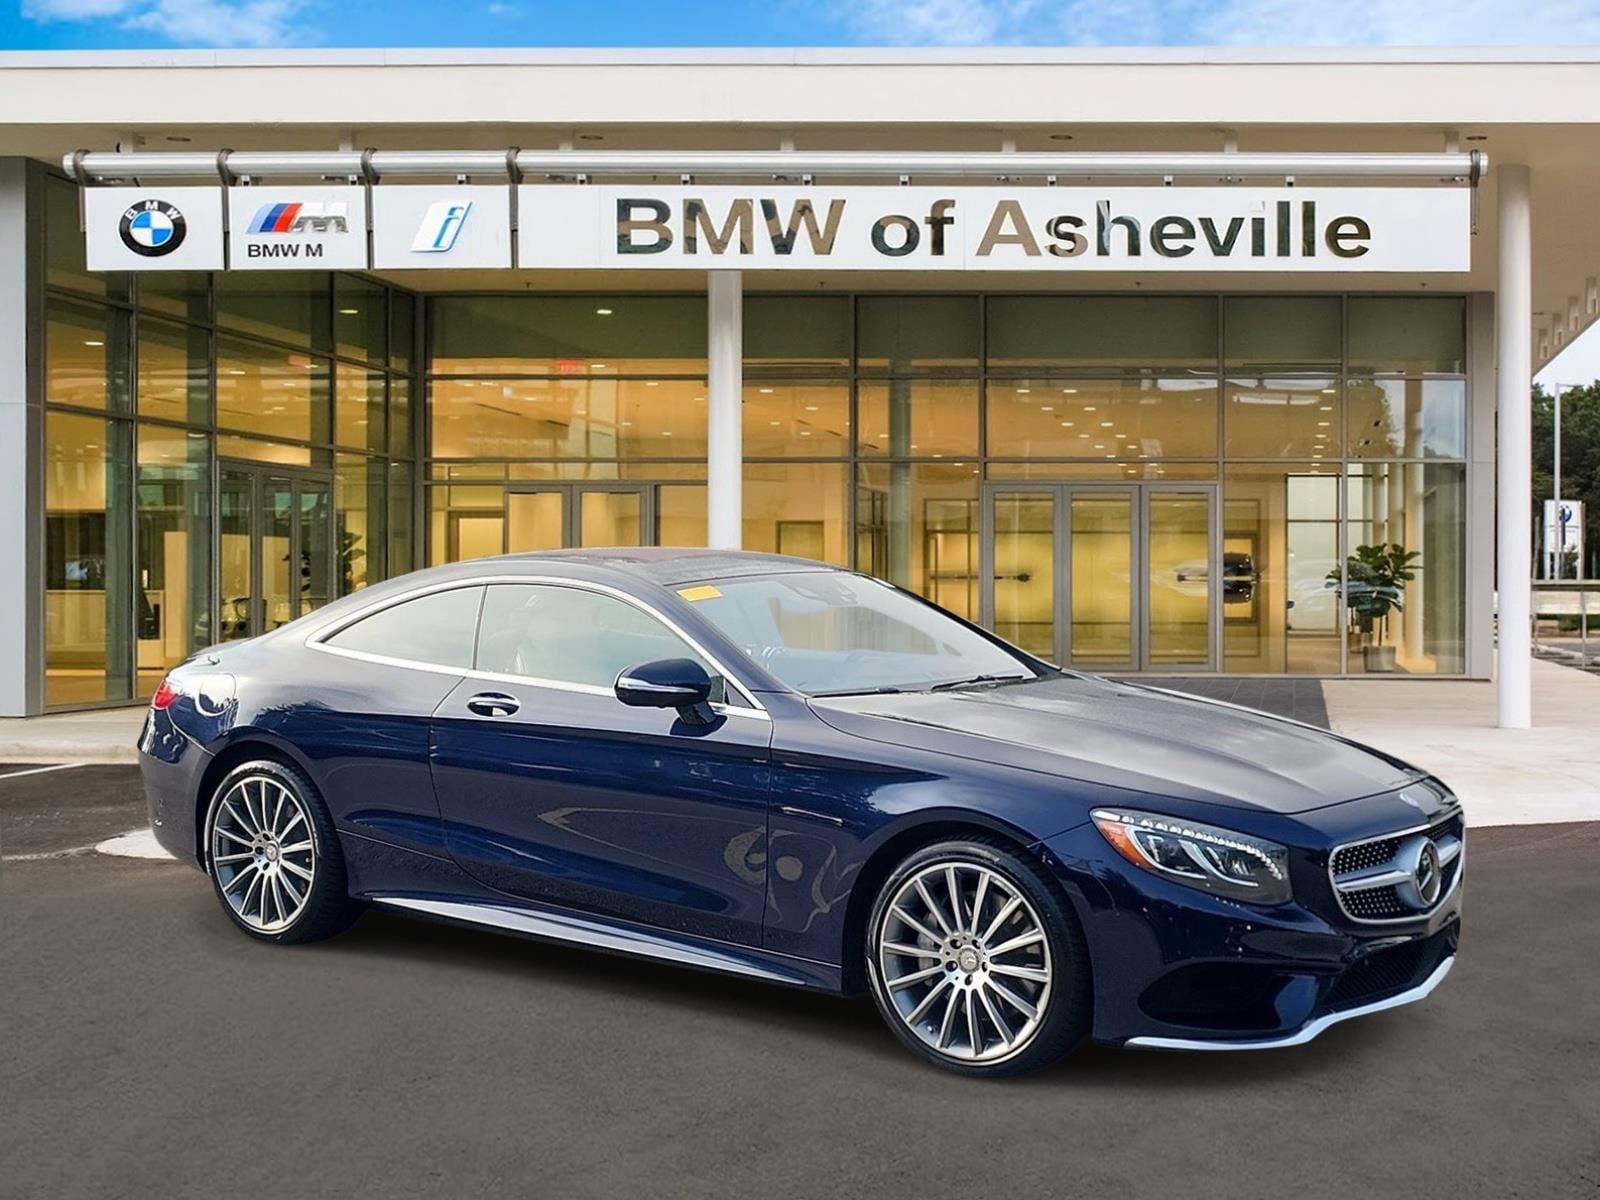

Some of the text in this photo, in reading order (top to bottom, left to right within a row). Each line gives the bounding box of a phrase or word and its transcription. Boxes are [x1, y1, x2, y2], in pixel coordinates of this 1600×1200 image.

[616, 199, 1371, 258] BMW of Asheville
[247, 243, 323, 258] BMW M
